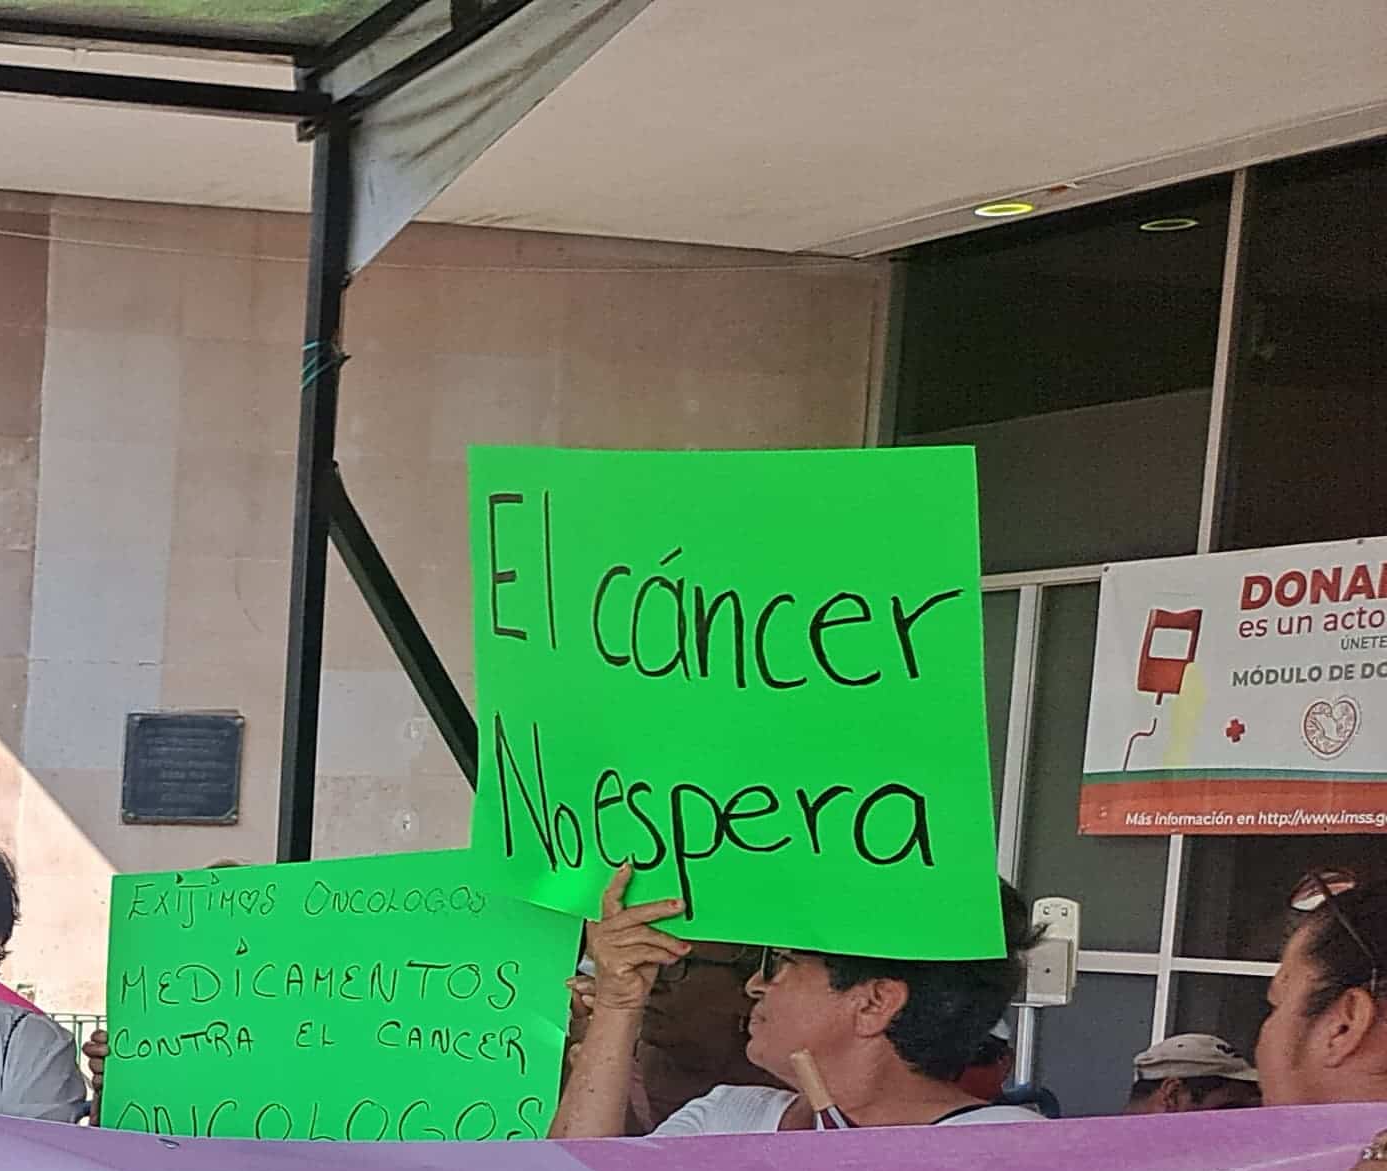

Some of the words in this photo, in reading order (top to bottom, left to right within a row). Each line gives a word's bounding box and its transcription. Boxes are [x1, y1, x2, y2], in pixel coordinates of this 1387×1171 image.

[489, 490, 556, 649] El
[593, 547, 964, 689] cáncer
[1238, 618, 1267, 638] es
[1277, 615, 1312, 636] un
[1323, 606, 1386, 632] acto
[1232, 664, 1322, 688] MÓDULO
[1328, 662, 1355, 681] DE
[1125, 811, 1152, 826] Más
[1154, 810, 1233, 826] información
[1236, 814, 1255, 825] en
[1257, 808, 1387, 827] http://www.imss.g
[120, 937, 521, 1010] MEDICAMENTOS
[112, 1021, 255, 1060] CONTRA
[295, 1021, 335, 1048] EL
[378, 1019, 528, 1075] CANCER
